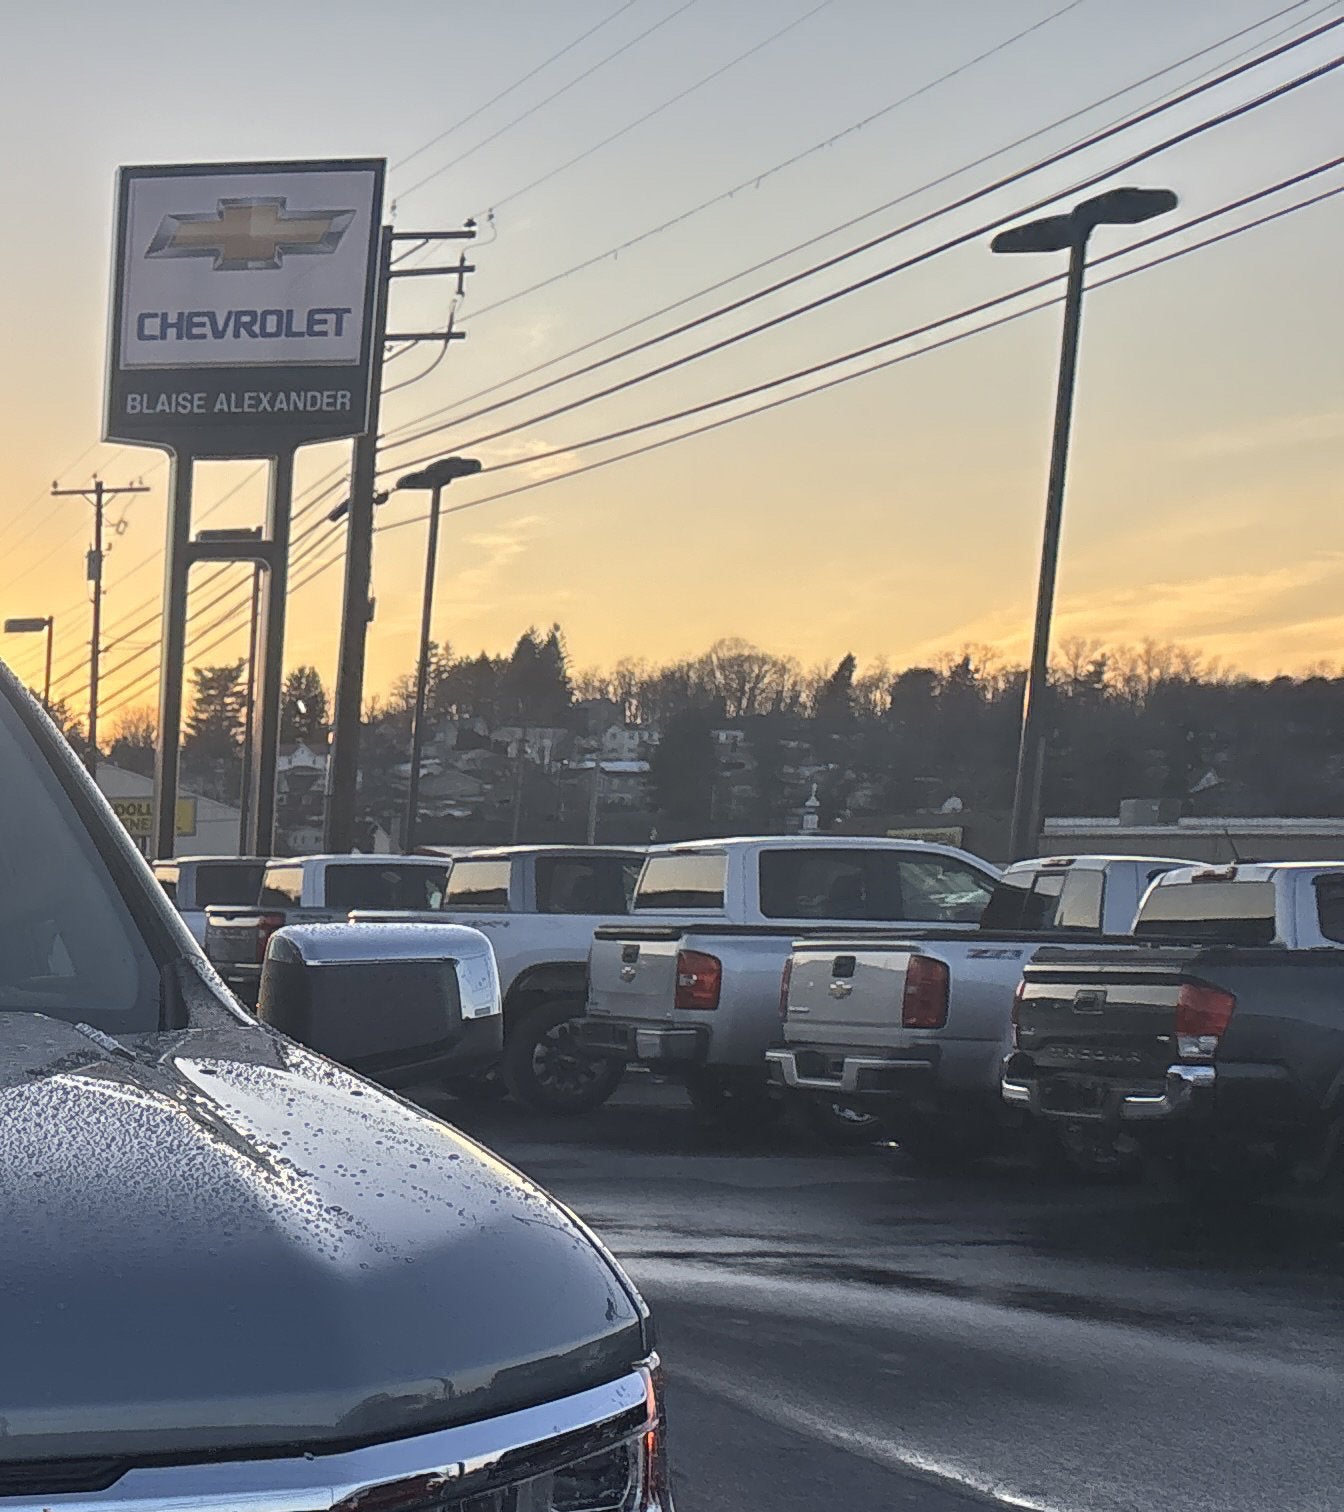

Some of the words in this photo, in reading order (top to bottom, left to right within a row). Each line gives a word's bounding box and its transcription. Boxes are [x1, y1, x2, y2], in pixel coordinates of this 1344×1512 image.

[136, 307, 353, 341] CHEVROLET
[126, 392, 208, 414] BLAISE
[213, 390, 352, 414] ALEXANDER
